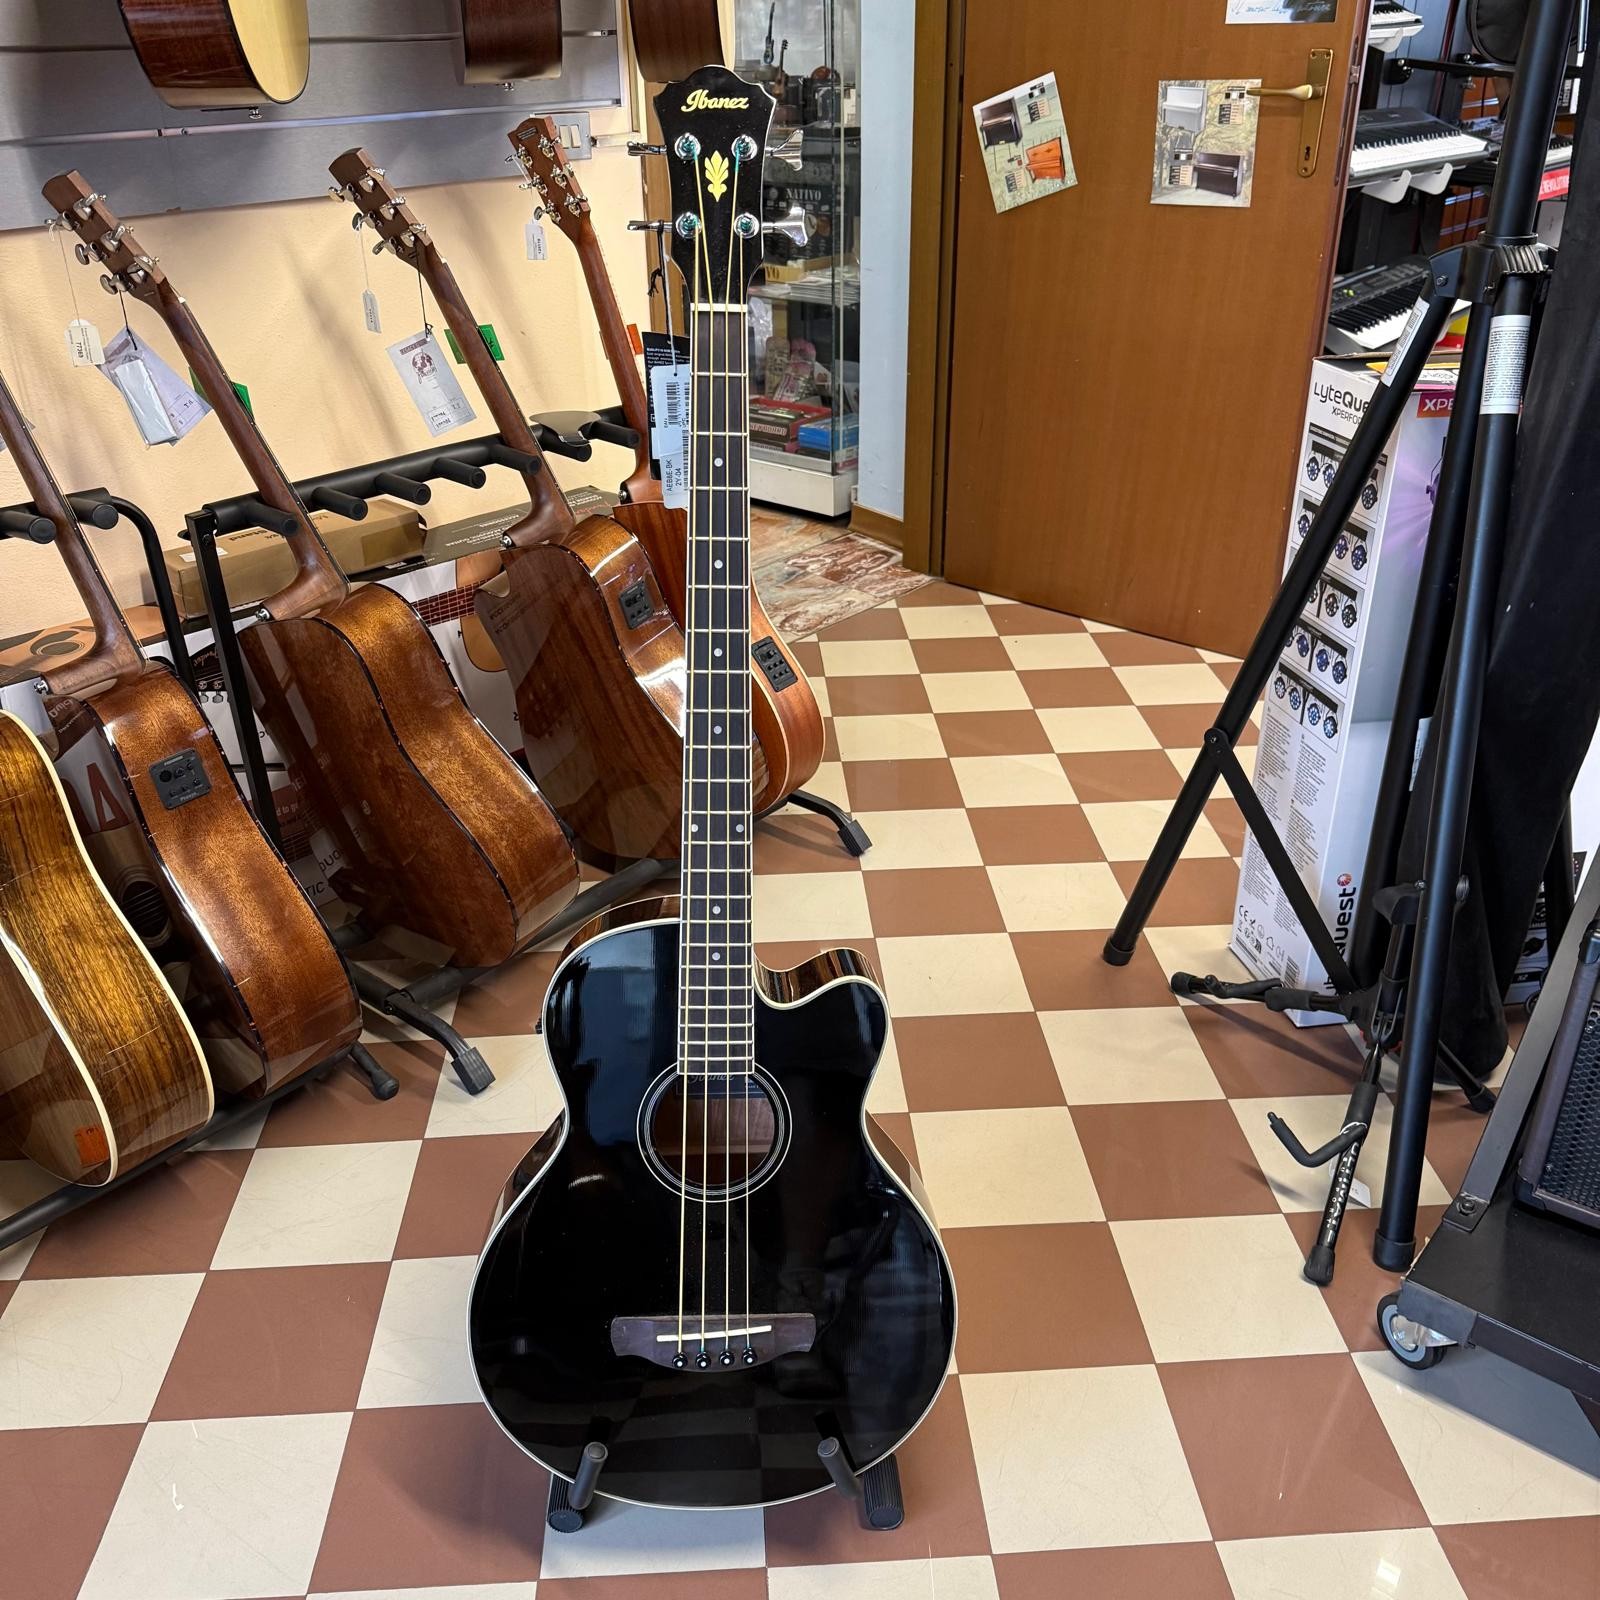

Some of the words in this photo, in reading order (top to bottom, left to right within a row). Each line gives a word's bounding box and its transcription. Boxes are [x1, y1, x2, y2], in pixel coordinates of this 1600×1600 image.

[681, 89, 749, 112] Ibanez
[786, 188, 821, 200] NATIVO
[1314, 382, 1370, 413] LyteQue
[1423, 398, 1454, 412] XPE
[1331, 406, 1362, 425] XPERFO
